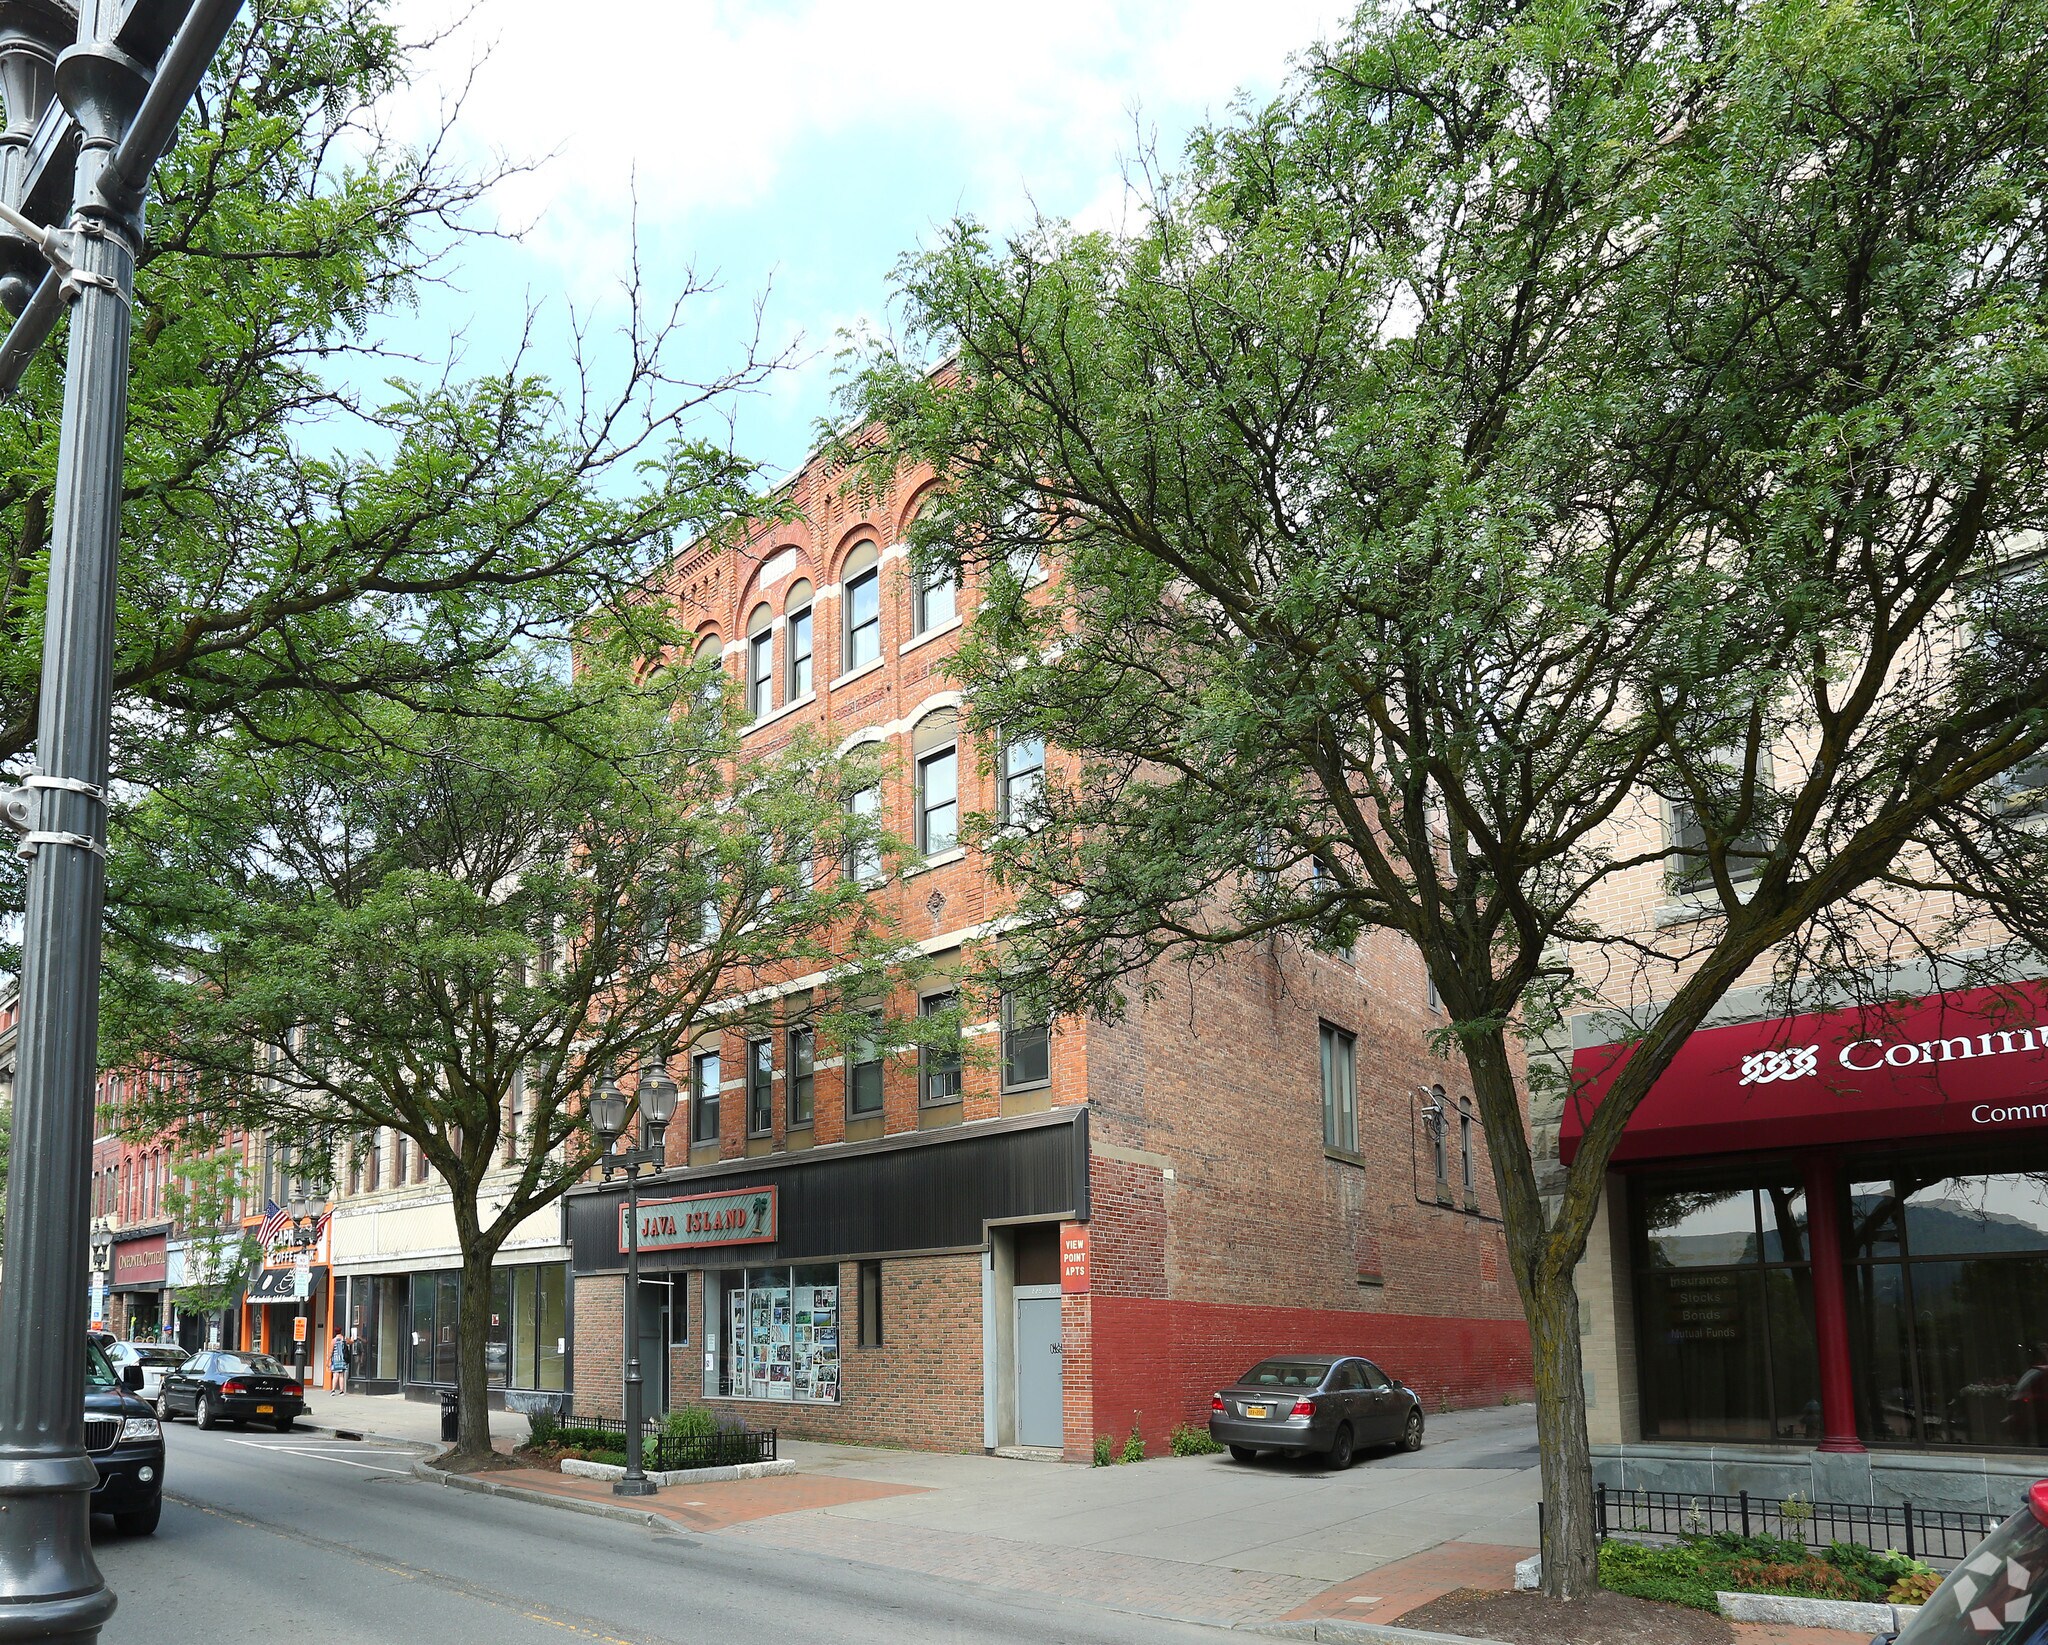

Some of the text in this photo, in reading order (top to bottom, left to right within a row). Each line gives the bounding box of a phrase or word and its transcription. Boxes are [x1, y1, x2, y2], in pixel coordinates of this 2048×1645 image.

[641, 1208, 747, 1237] JAVA ISLAND
[1065, 1239, 1084, 1250] VIEW
[1063, 1252, 1086, 1263] POINT
[1065, 1266, 1085, 1276] APTS
[1670, 1275, 1729, 1287] Insurance
[1680, 1293, 1721, 1303] Stocks
[1682, 1310, 1721, 1320] Bonds
[1671, 1327, 1736, 1339] Mutual Funds
